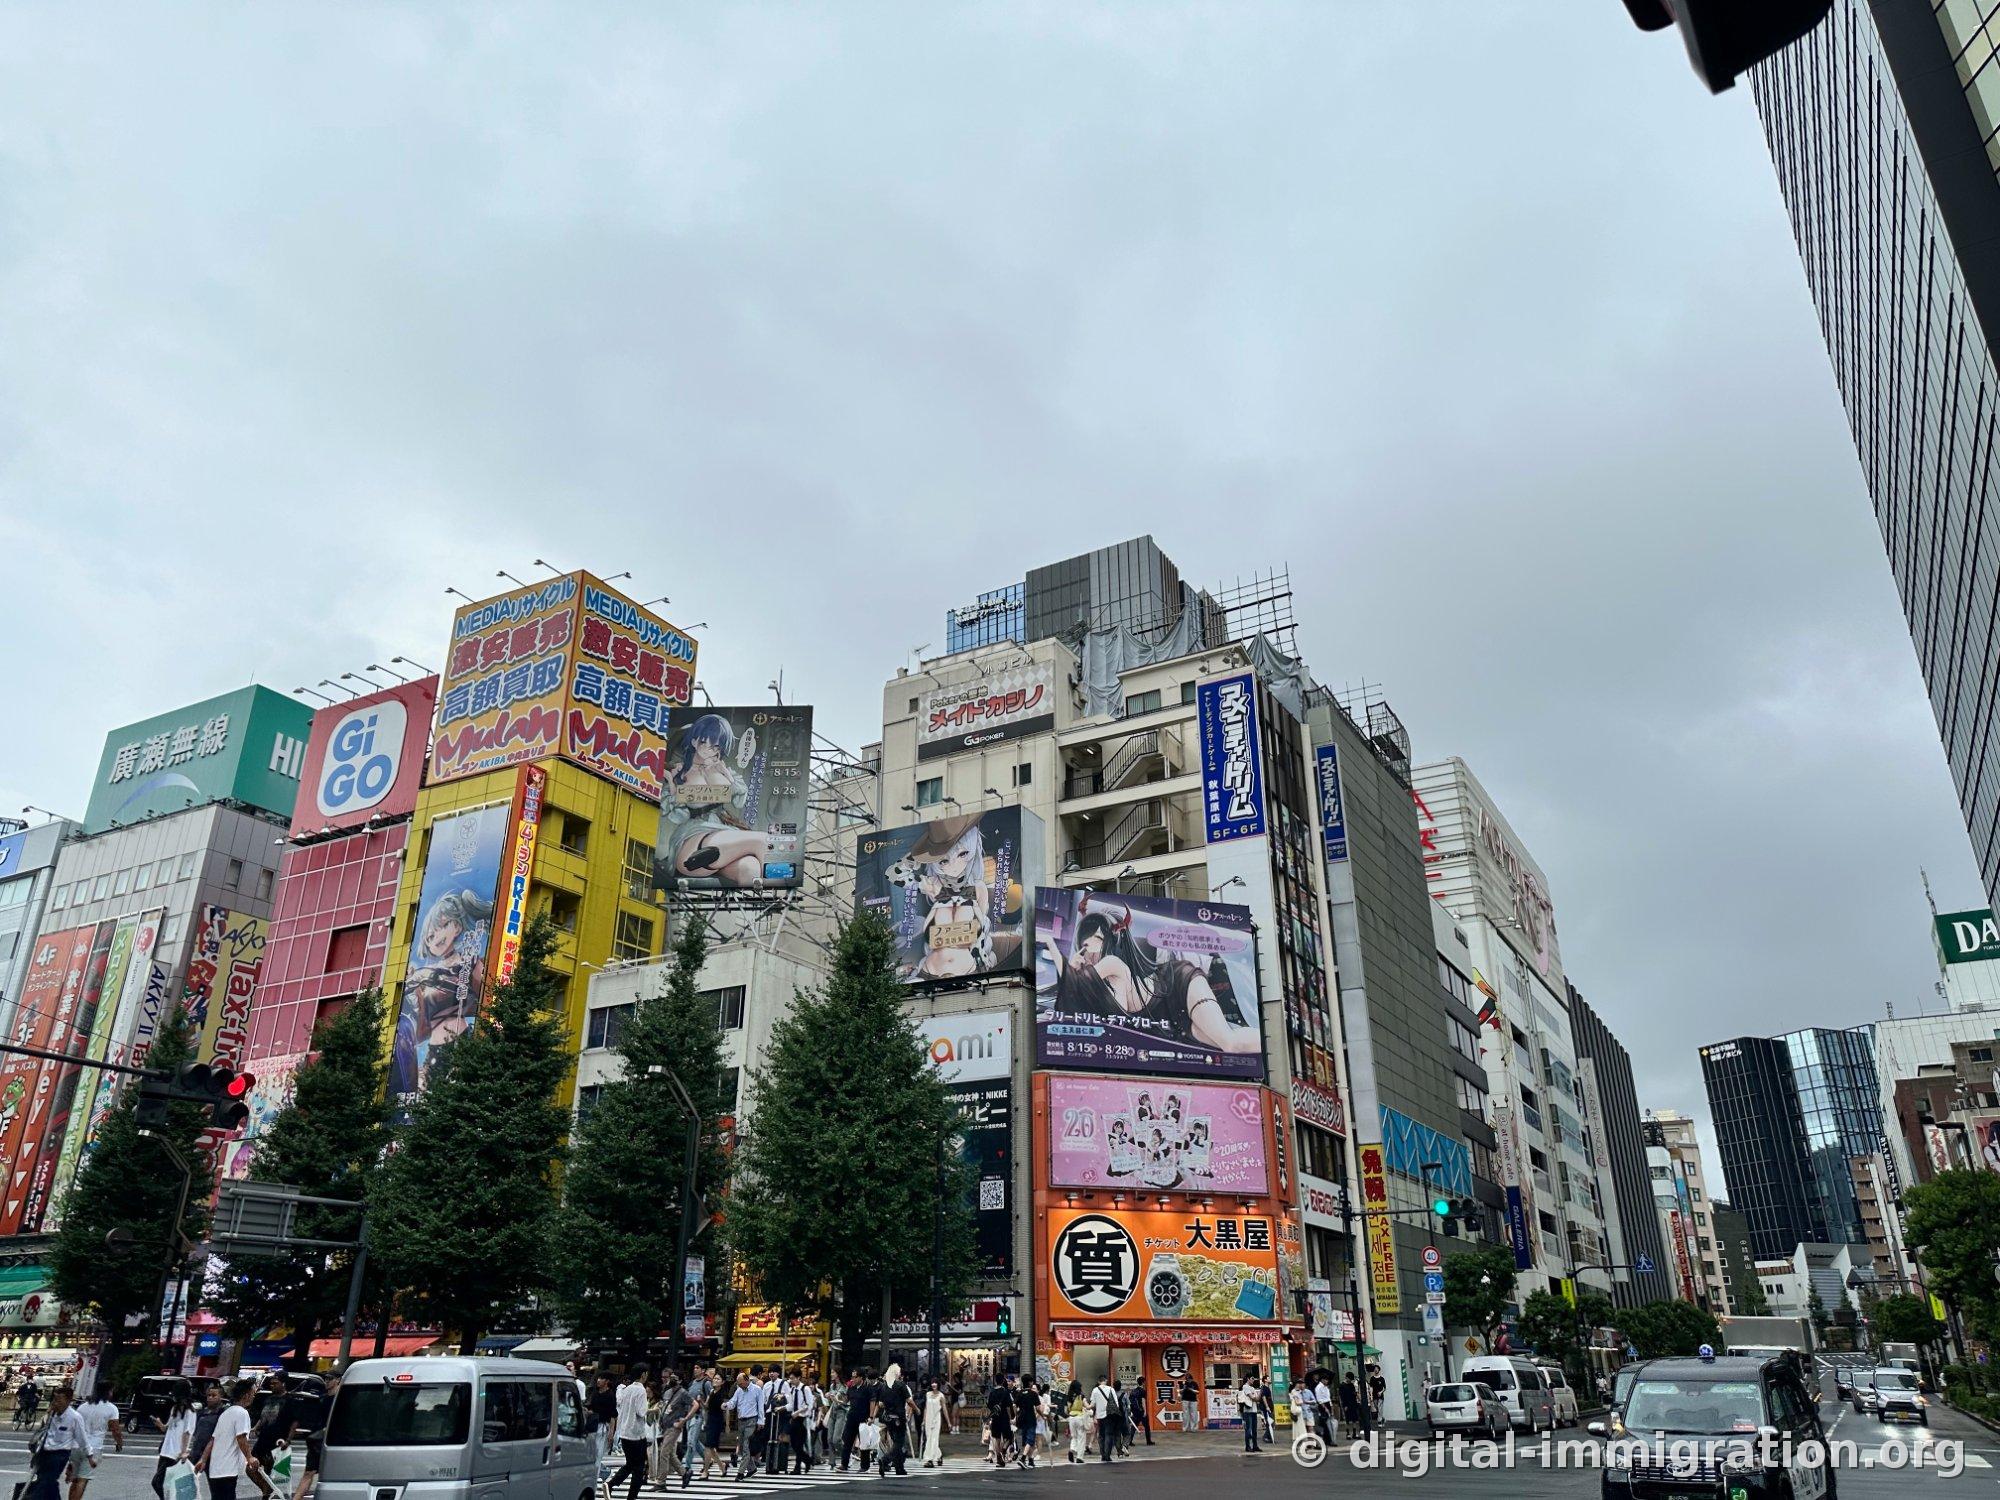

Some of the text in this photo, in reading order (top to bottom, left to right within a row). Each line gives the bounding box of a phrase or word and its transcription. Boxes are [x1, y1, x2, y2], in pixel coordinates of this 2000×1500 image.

[449, 609, 573, 679] 激安販売
[580, 617, 692, 704] 激安販売
[440, 655, 565, 726] 高額買取
[928, 684, 1044, 732] メイドカジノ
[108, 713, 231, 785] 廣瀬無線
[435, 705, 560, 778] Mulan
[479, 756, 506, 770] AKIBA
[613, 769, 639, 787] AKIBA
[1208, 779, 1221, 824] 秋葉原店
[36, 944, 57, 966] 4F
[141, 965, 166, 1023] AKKY
[212, 958, 263, 1069] Tax-fre
[1361, 1149, 1387, 1203] 免税
[1144, 1217, 1272, 1250] チケット 大黒屋
[1512, 1205, 1525, 1251] GALLERIA
[1065, 1230, 1129, 1301] 質
[1383, 1242, 1396, 1283] FREE
[1426, 1251, 1437, 1261] 40
